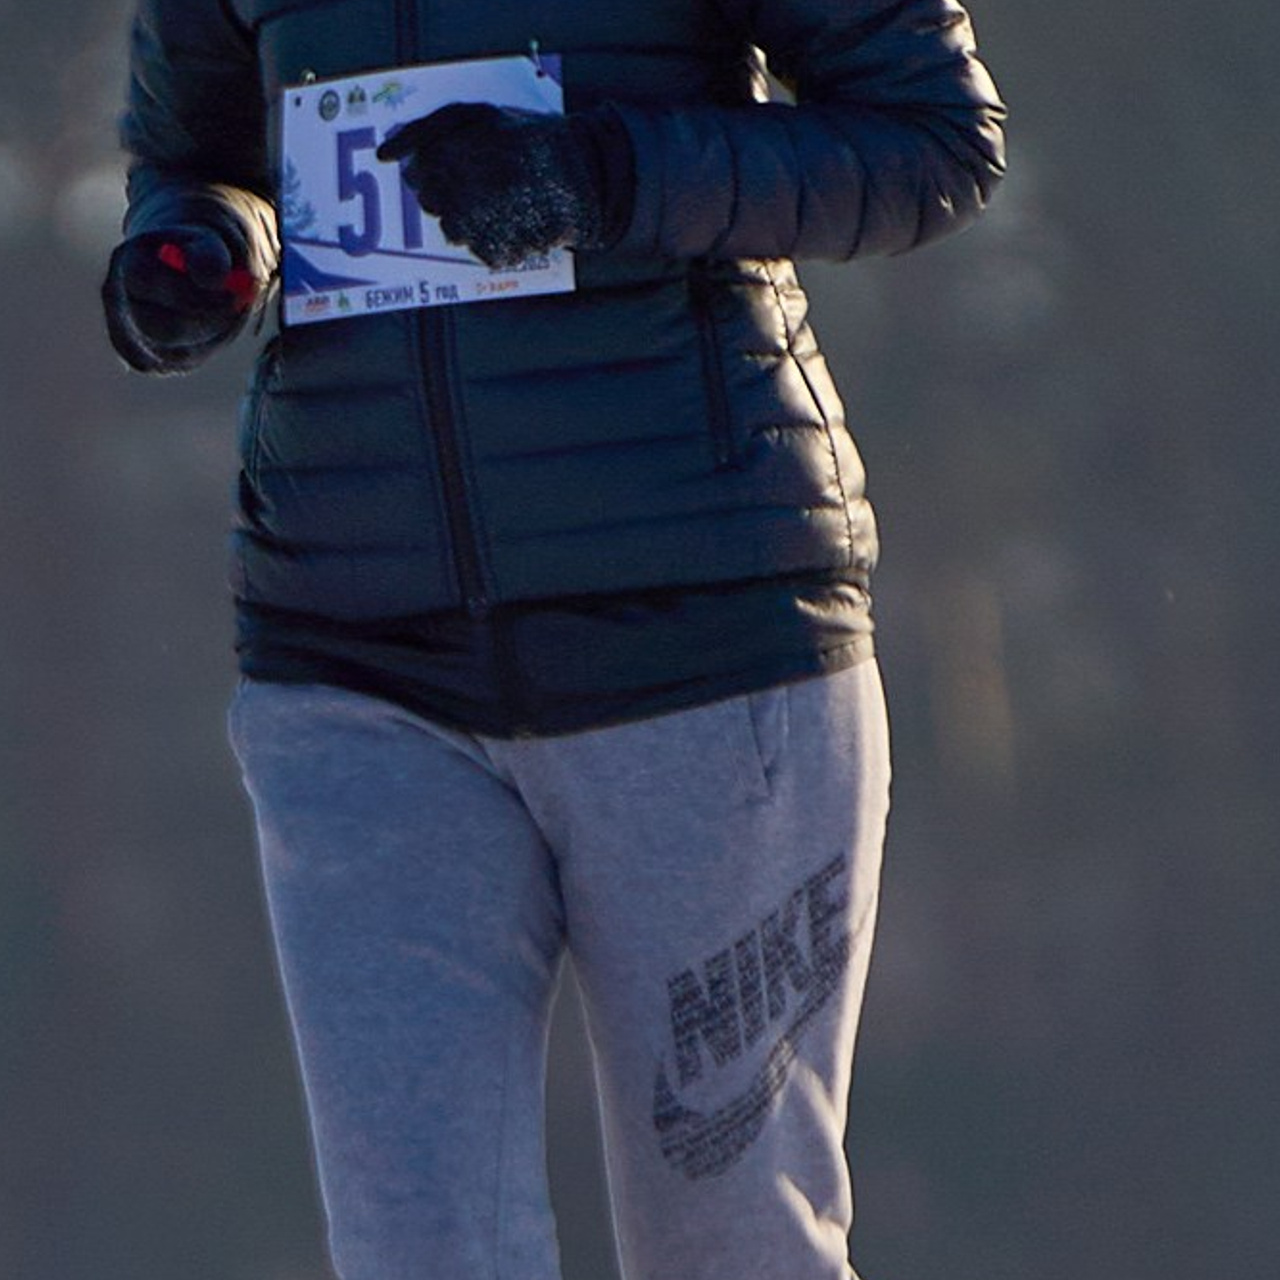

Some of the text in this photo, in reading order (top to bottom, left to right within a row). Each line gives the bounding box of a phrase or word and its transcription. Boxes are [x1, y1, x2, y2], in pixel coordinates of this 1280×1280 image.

[336, 123, 424, 257] 51
[365, 284, 414, 309] БЕЖИМ
[419, 280, 430, 304] 5
[435, 283, 460, 301] год
[667, 852, 850, 1088] NIKE
